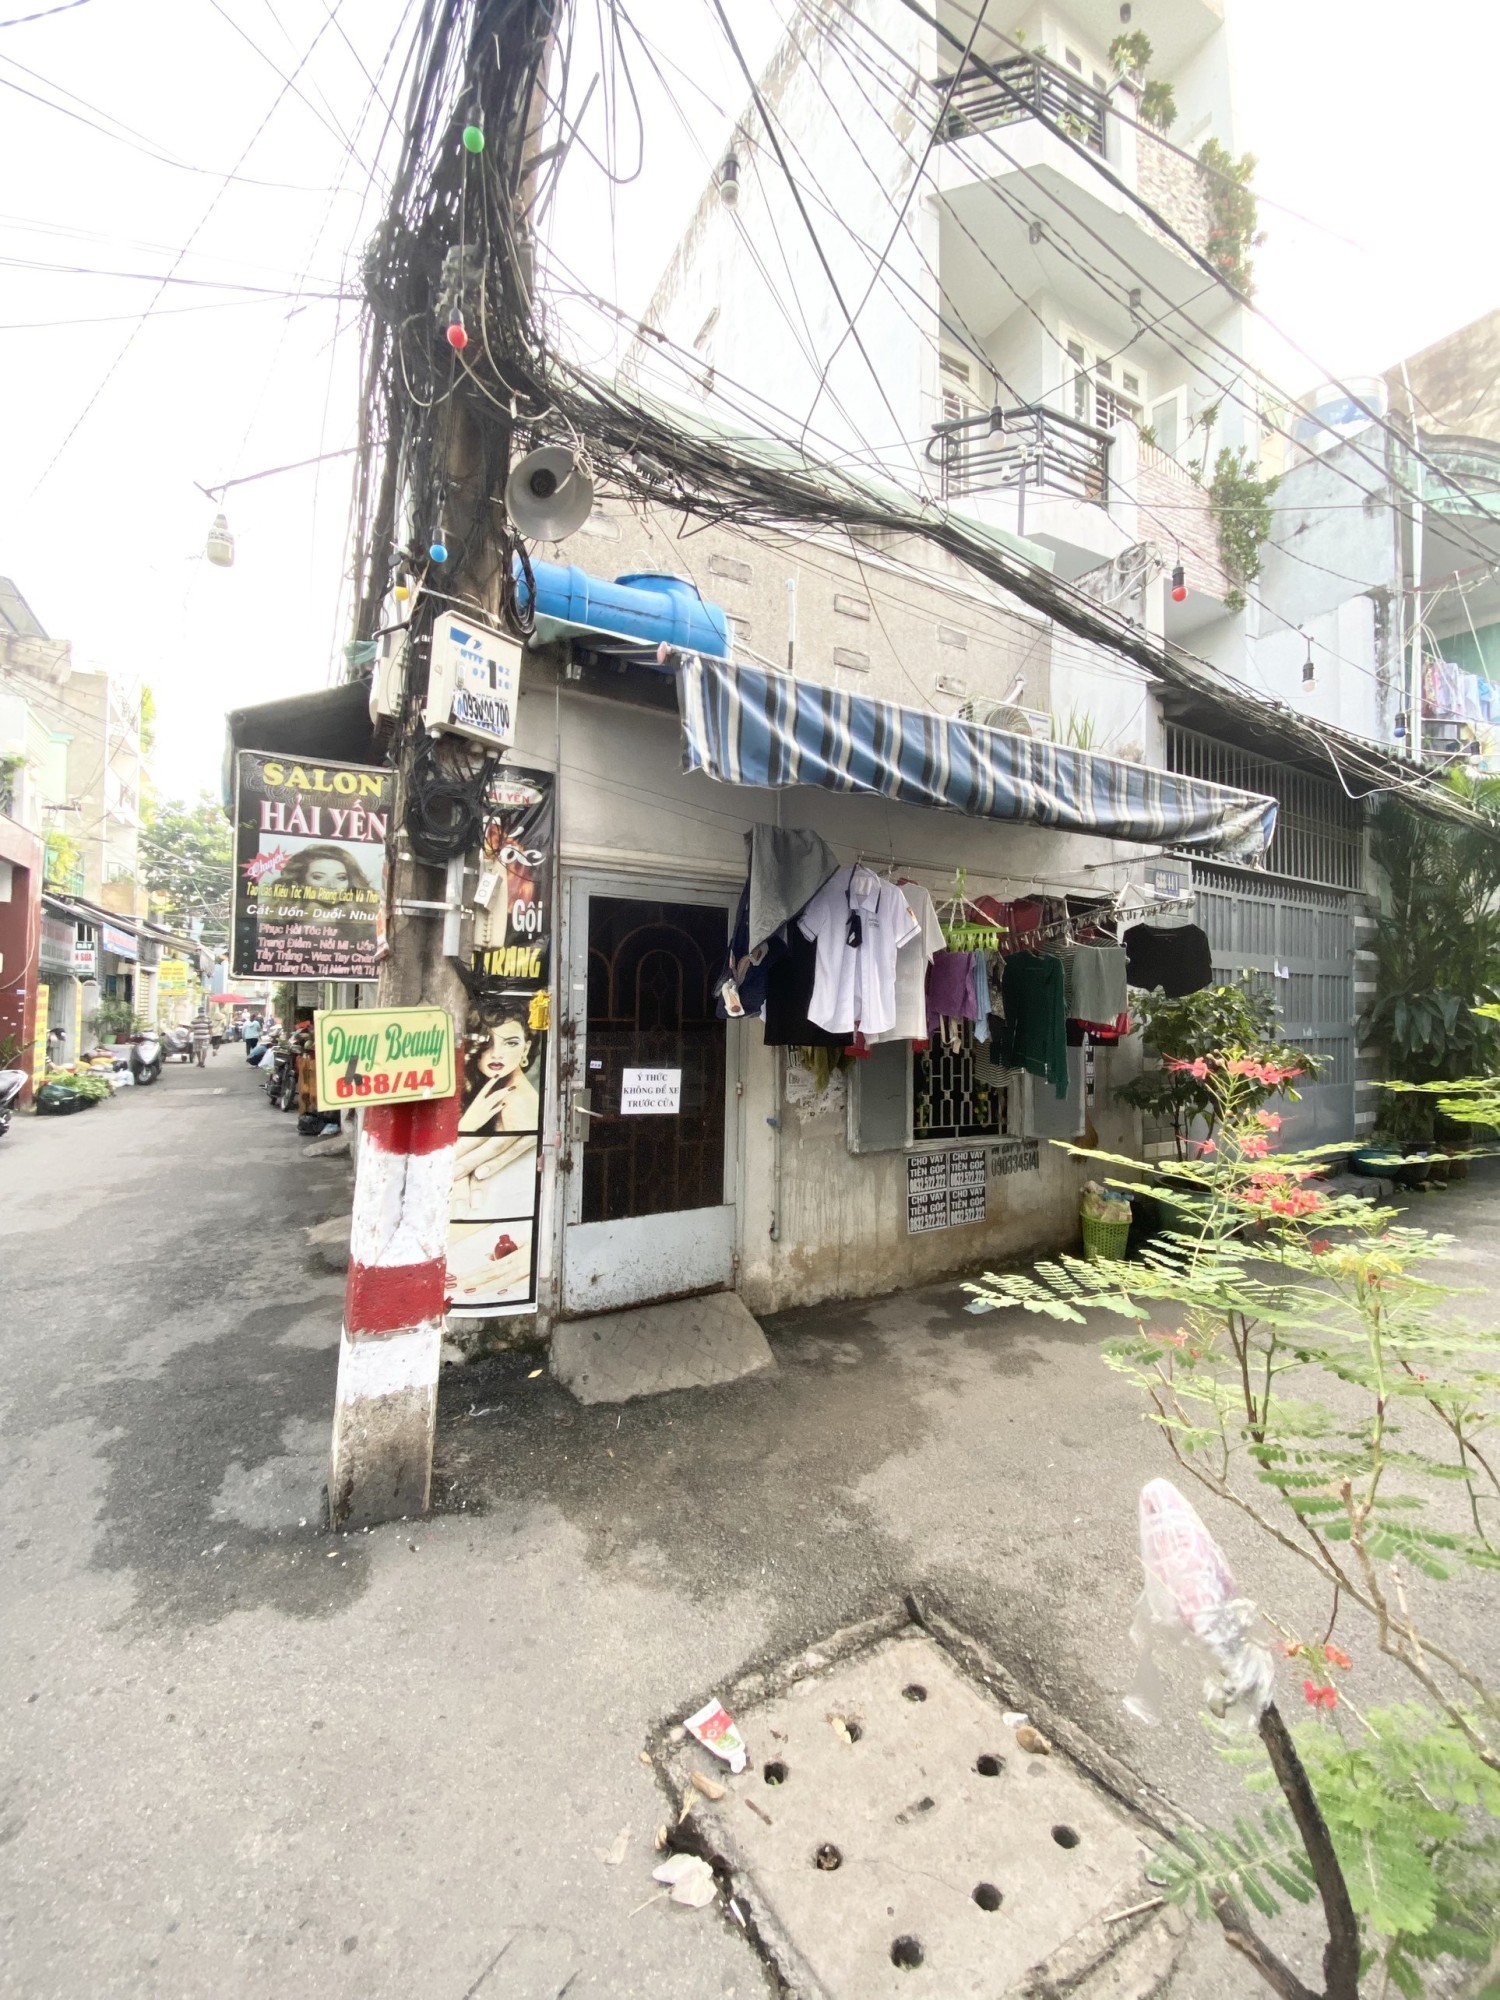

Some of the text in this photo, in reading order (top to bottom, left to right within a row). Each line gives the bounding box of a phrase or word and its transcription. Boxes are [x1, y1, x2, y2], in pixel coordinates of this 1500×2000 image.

[262, 762, 384, 797] SALON
[260, 793, 388, 841] HẢI YẾN
[512, 899, 543, 940] Gội
[258, 923, 284, 936] Phục
[257, 936, 286, 950] Trang
[253, 961, 273, 973] Làm
[327, 1023, 445, 1073] Dung Beauty
[336, 1068, 436, 1099] 688/44
[637, 1072, 668, 1082] Ý THỨC
[623, 1084, 680, 1095] KHÔNG ĐỂ XE
[627, 1097, 674, 1108] TRƯỚC CỬA
[911, 1154, 944, 1167] CHO VAY
[952, 1150, 984, 1161] CHO VAY
[910, 1164, 946, 1178] TIỀN GÓP
[951, 1160, 985, 1172] TIỀN GÓP
[911, 1191, 944, 1205] CHO VAY
[952, 1187, 984, 1199] CHO VAY
[910, 1201, 946, 1216] TIỀN GÓP
[951, 1196, 985, 1210] TIỀN GÓP
